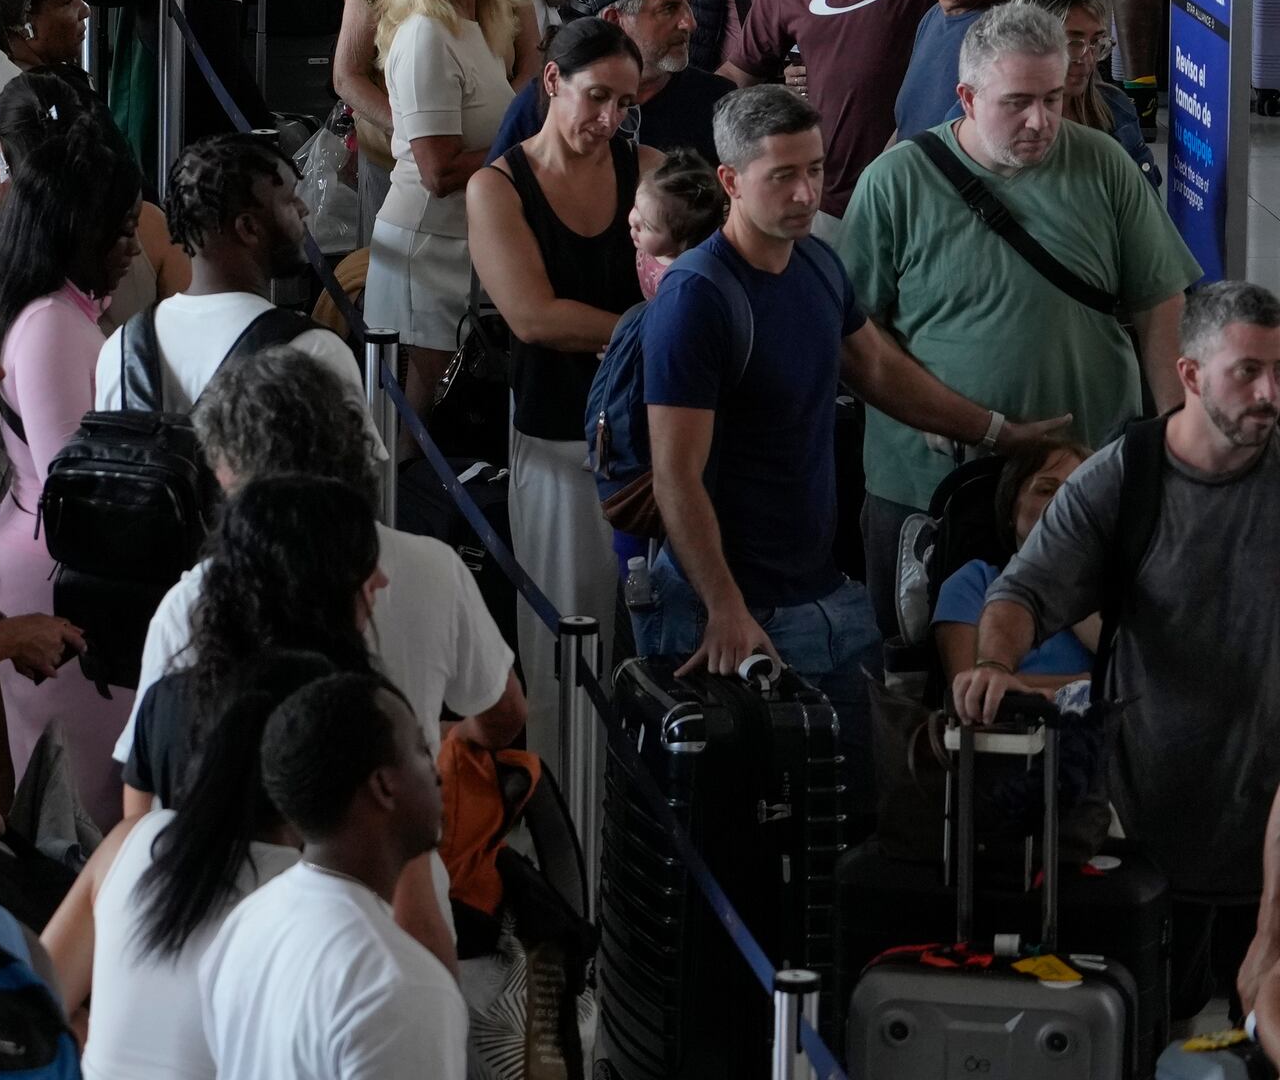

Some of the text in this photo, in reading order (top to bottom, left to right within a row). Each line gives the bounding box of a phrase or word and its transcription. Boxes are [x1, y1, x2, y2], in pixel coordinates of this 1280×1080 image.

[1175, 45, 1206, 88] Revisa el
[1175, 82, 1211, 129] tamaño de
[1183, 127, 1214, 168] equipaje.
[1174, 153, 1188, 177] Check
[1204, 178, 1209, 193] of
